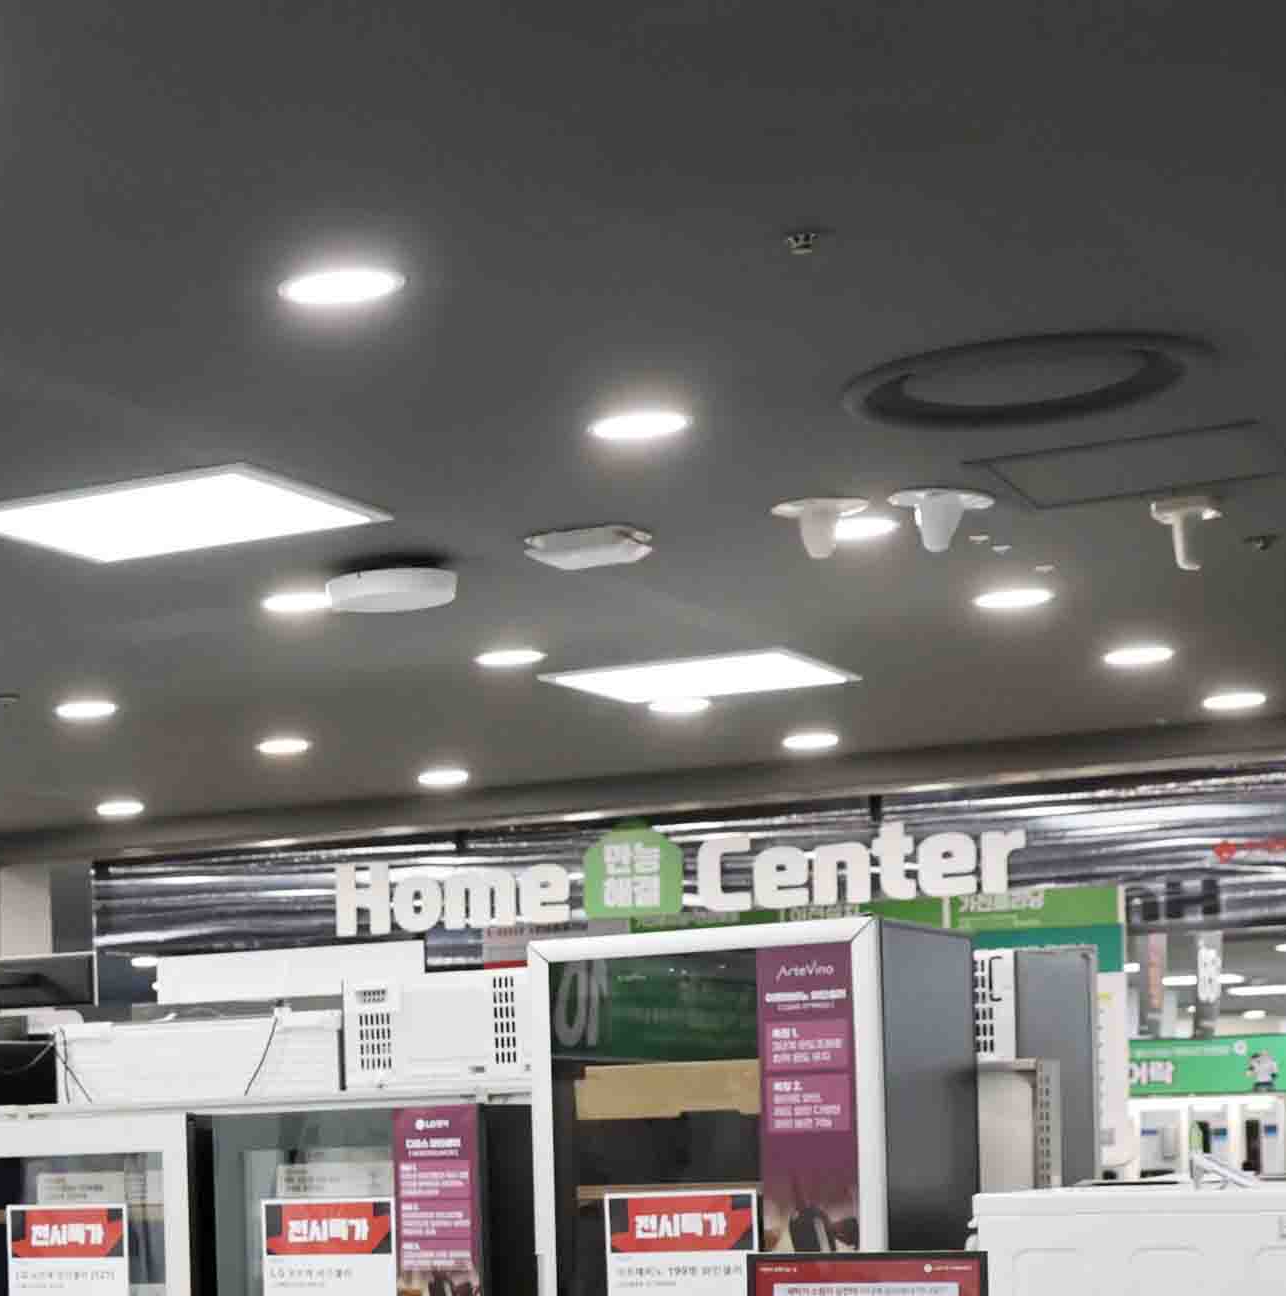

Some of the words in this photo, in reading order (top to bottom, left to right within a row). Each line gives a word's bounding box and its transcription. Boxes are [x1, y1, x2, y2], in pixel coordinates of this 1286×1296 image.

[335, 862, 571, 937] Home
[697, 821, 1027, 913] Center
[776, 961, 834, 981] ArteVino
